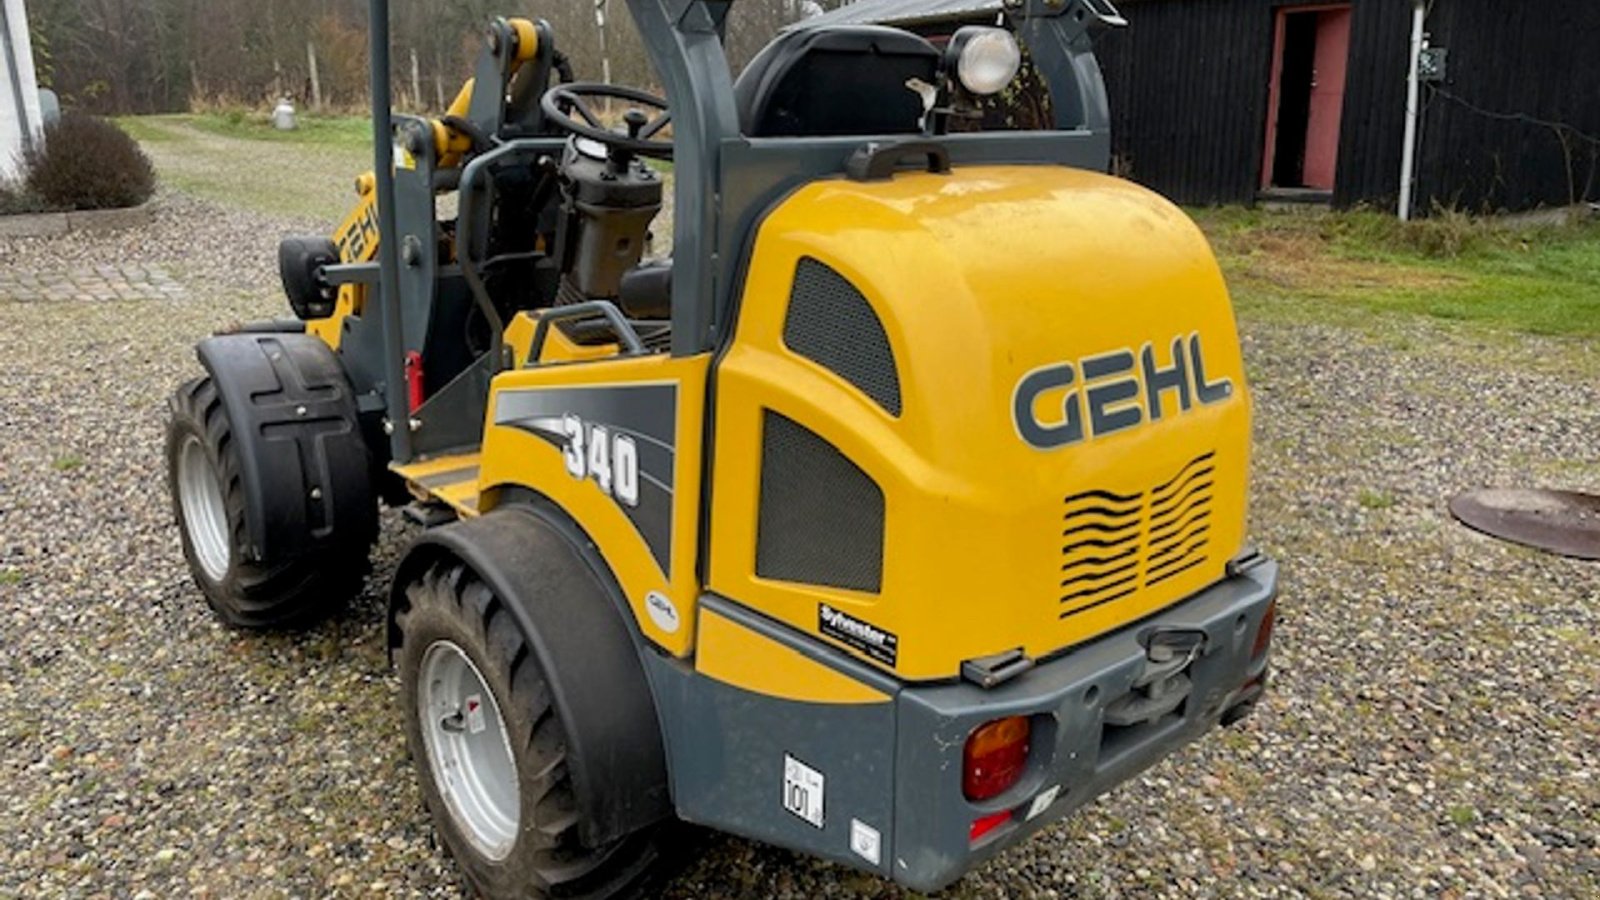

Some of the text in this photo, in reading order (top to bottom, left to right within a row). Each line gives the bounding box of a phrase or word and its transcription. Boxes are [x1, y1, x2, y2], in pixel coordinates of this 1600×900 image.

[1012, 331, 1233, 451] GEHL
[562, 411, 639, 506] 340
[787, 779, 809, 816] 101
